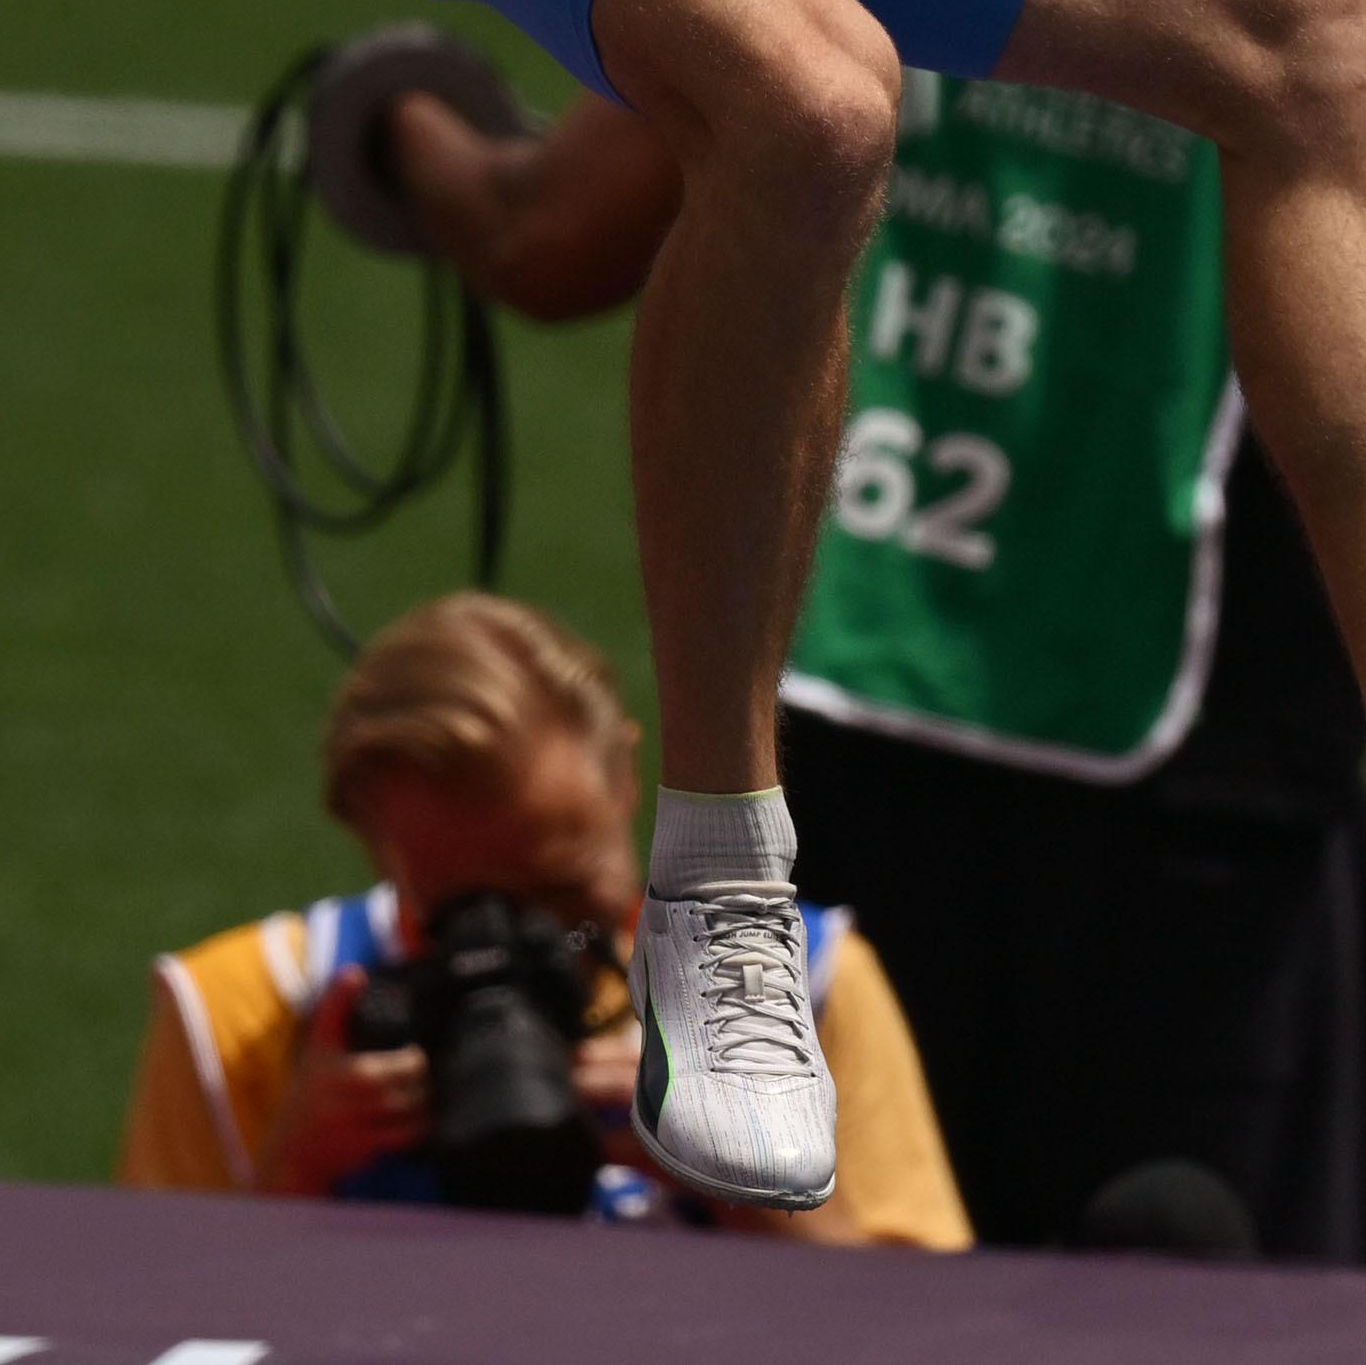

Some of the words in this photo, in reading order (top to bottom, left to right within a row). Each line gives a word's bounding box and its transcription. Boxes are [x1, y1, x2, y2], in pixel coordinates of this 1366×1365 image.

[870, 260, 1039, 398] HB
[833, 408, 1011, 572] 62
[739, 930, 761, 938] JUMP
